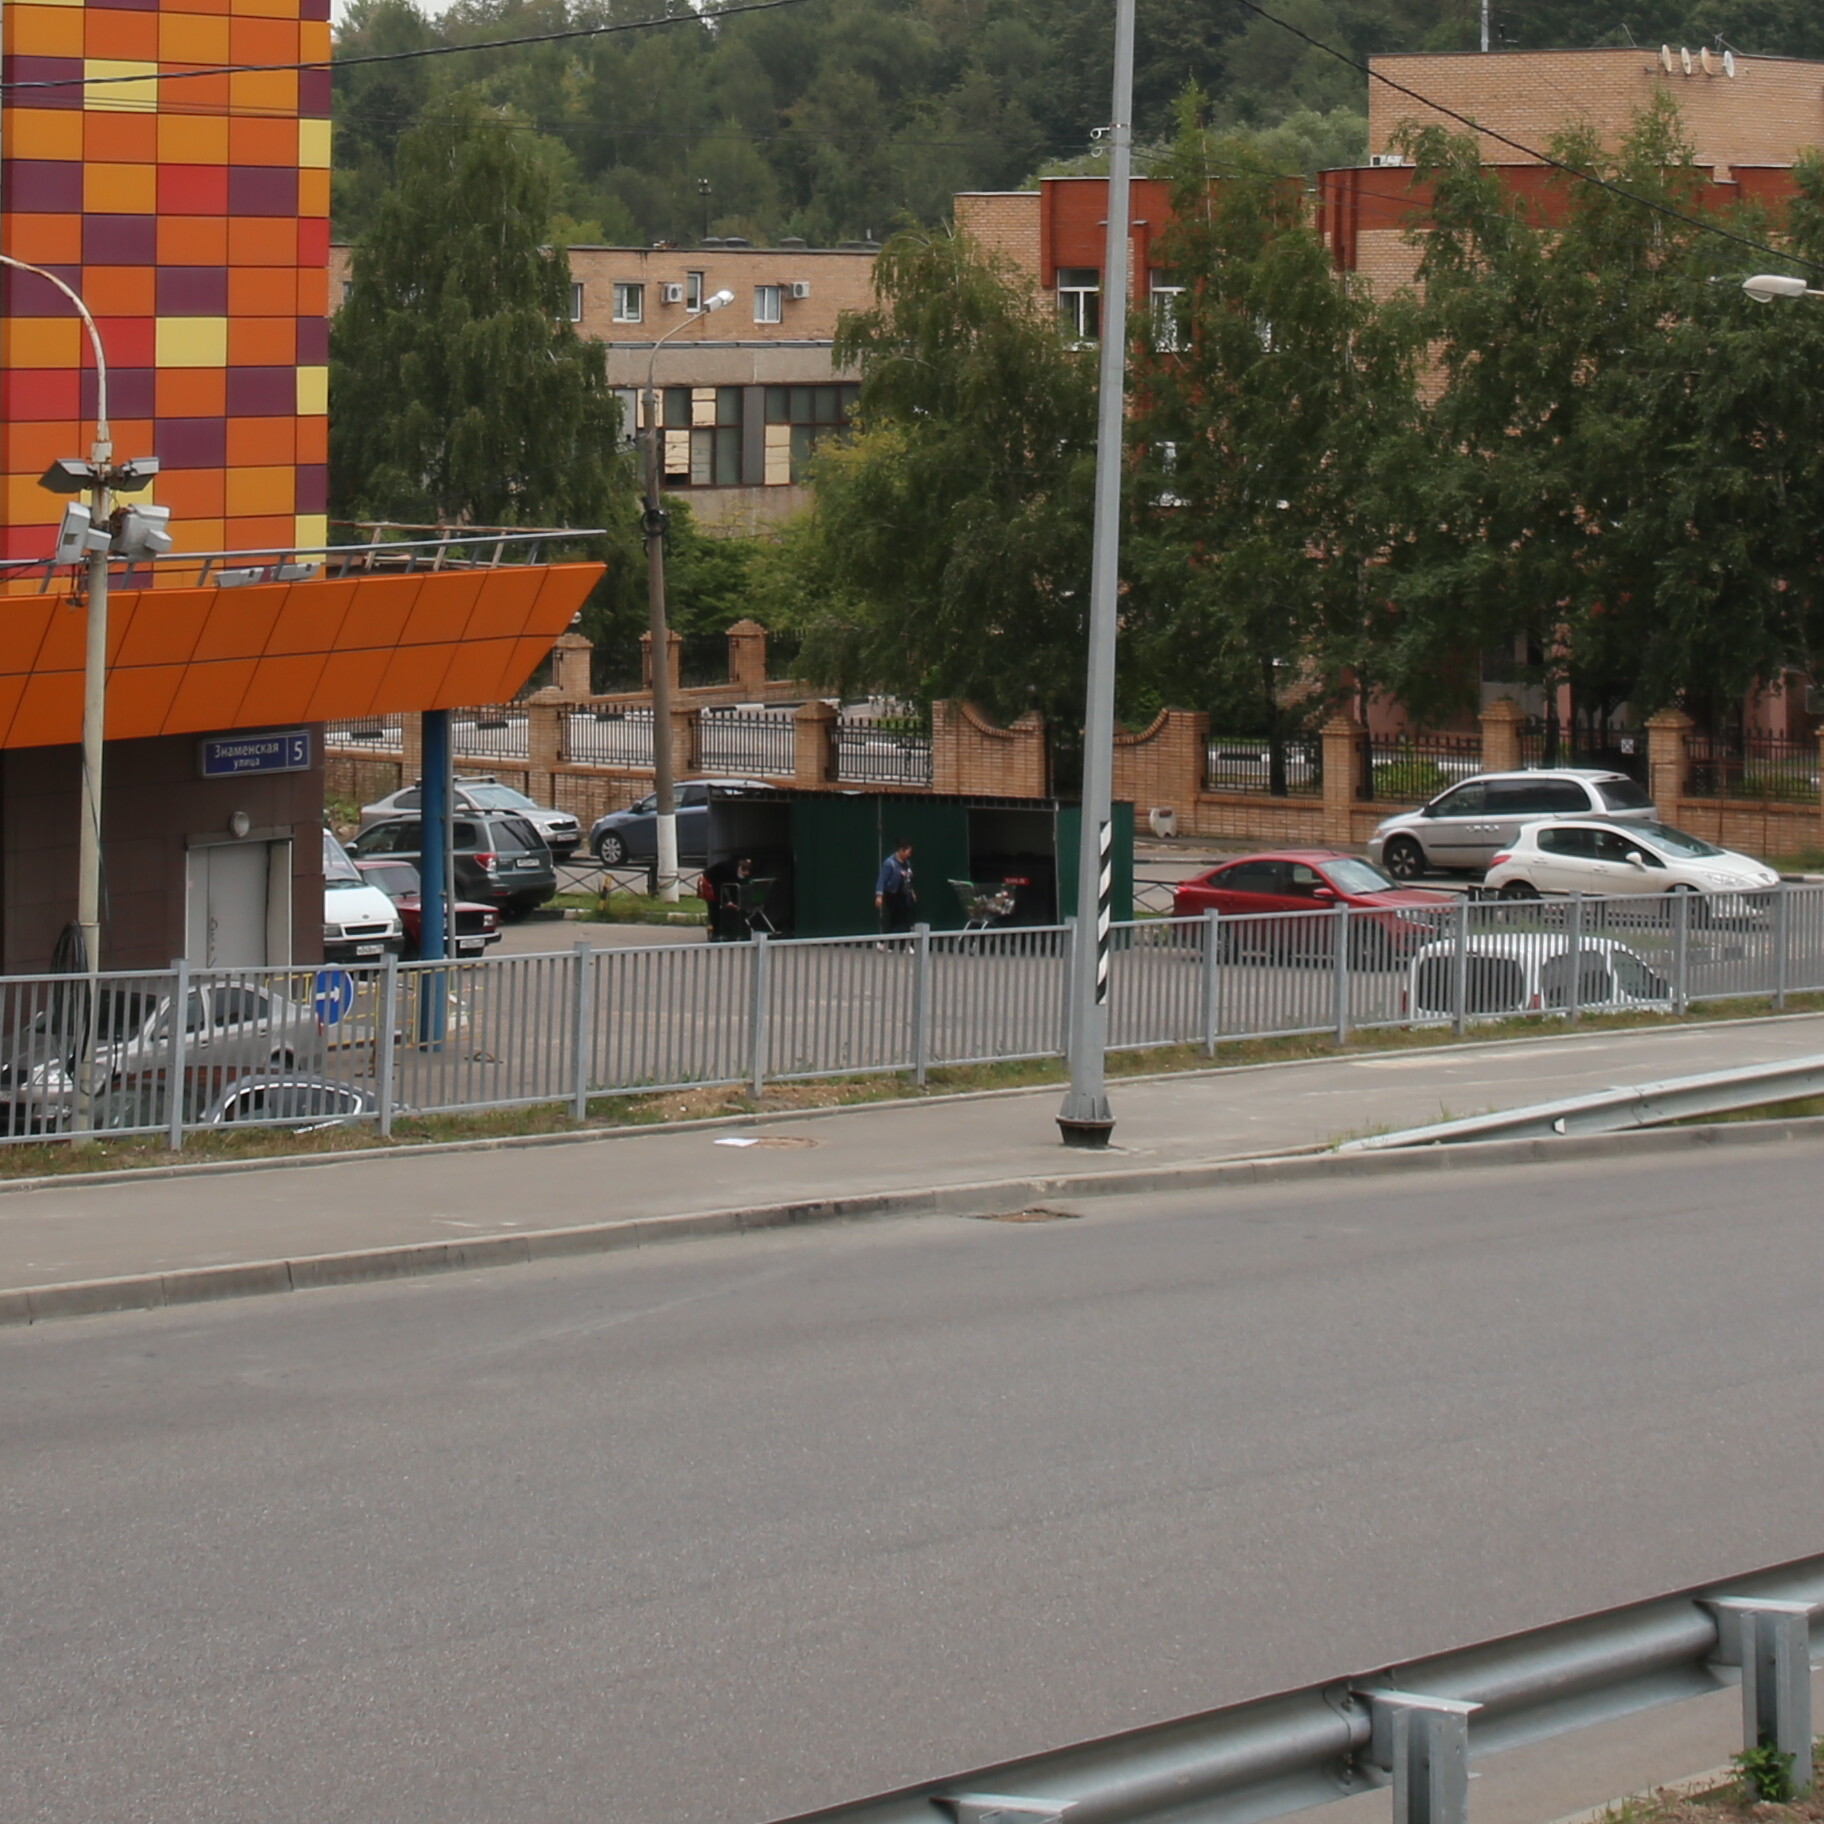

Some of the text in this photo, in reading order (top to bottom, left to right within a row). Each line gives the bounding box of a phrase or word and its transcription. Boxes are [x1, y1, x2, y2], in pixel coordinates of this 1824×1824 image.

[214, 741, 303, 761] Знаменская 5
[233, 758, 260, 770] улица
